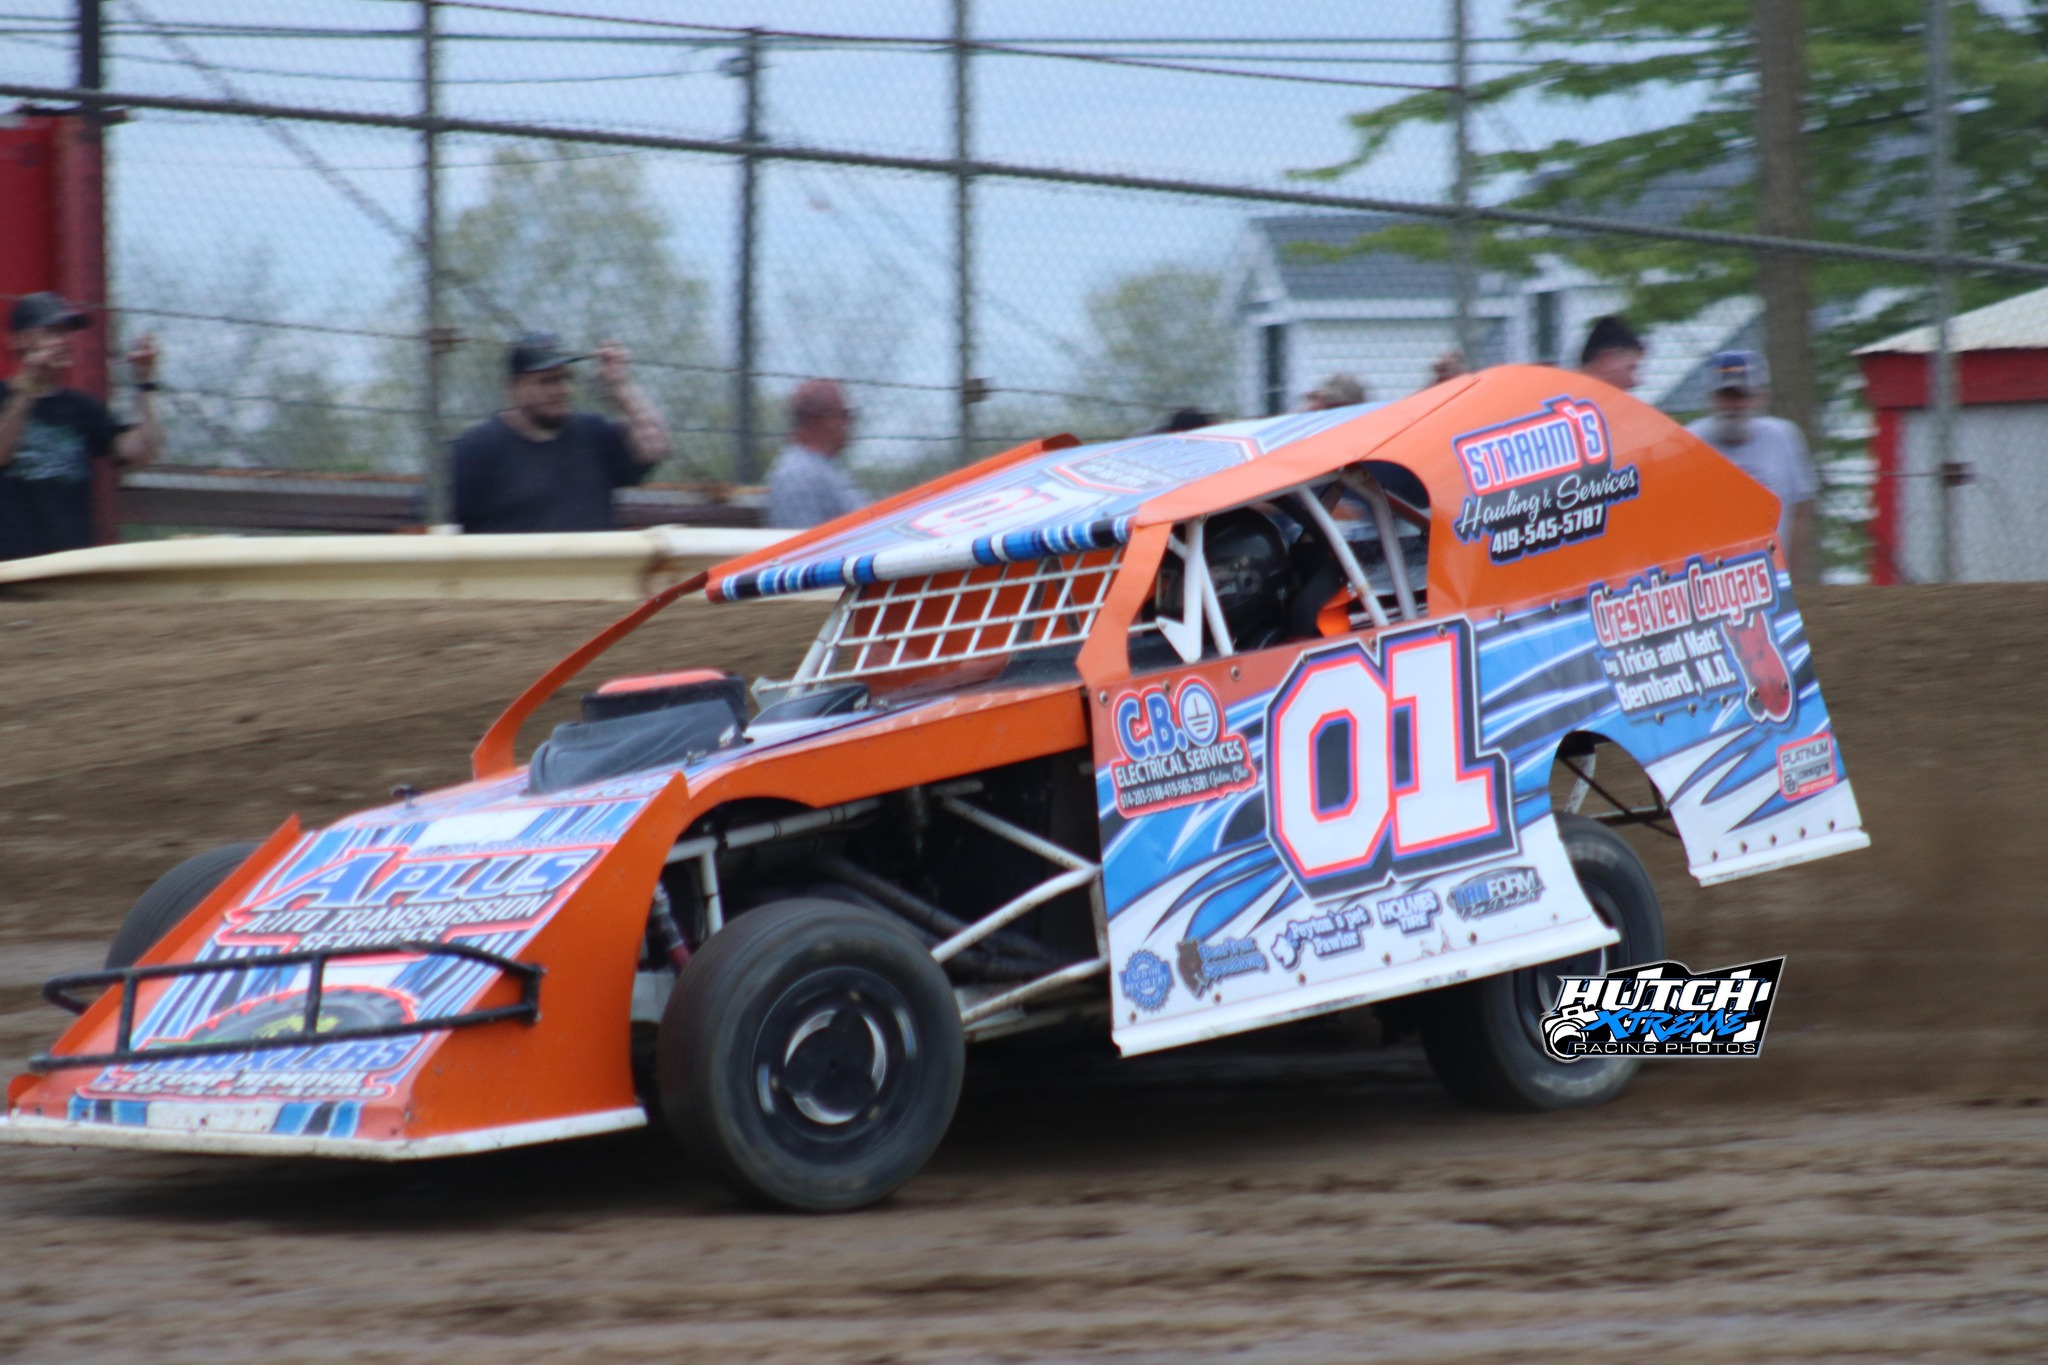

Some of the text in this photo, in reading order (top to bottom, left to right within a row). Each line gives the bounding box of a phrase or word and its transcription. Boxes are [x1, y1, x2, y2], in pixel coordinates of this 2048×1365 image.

[1457, 490, 1541, 534] Hauling
[1557, 468, 1636, 510] Services
[1492, 504, 1604, 554] 419-545-5787
[1590, 558, 1773, 648] Crestview Cougars
[1616, 645, 1659, 677] Tricia
[1658, 634, 1688, 666] and
[1684, 628, 1723, 659] Matt
[1695, 655, 1737, 690] M.D.
[1115, 740, 1244, 788] ELECTRICAL SERVICES
[1272, 630, 1498, 879] 01
[240, 894, 552, 934] AUTO TRANSMISSION
[1345, 905, 1367, 931] pet
[1379, 891, 1438, 921] HOLMES
[1400, 914, 1429, 933] TIRE
